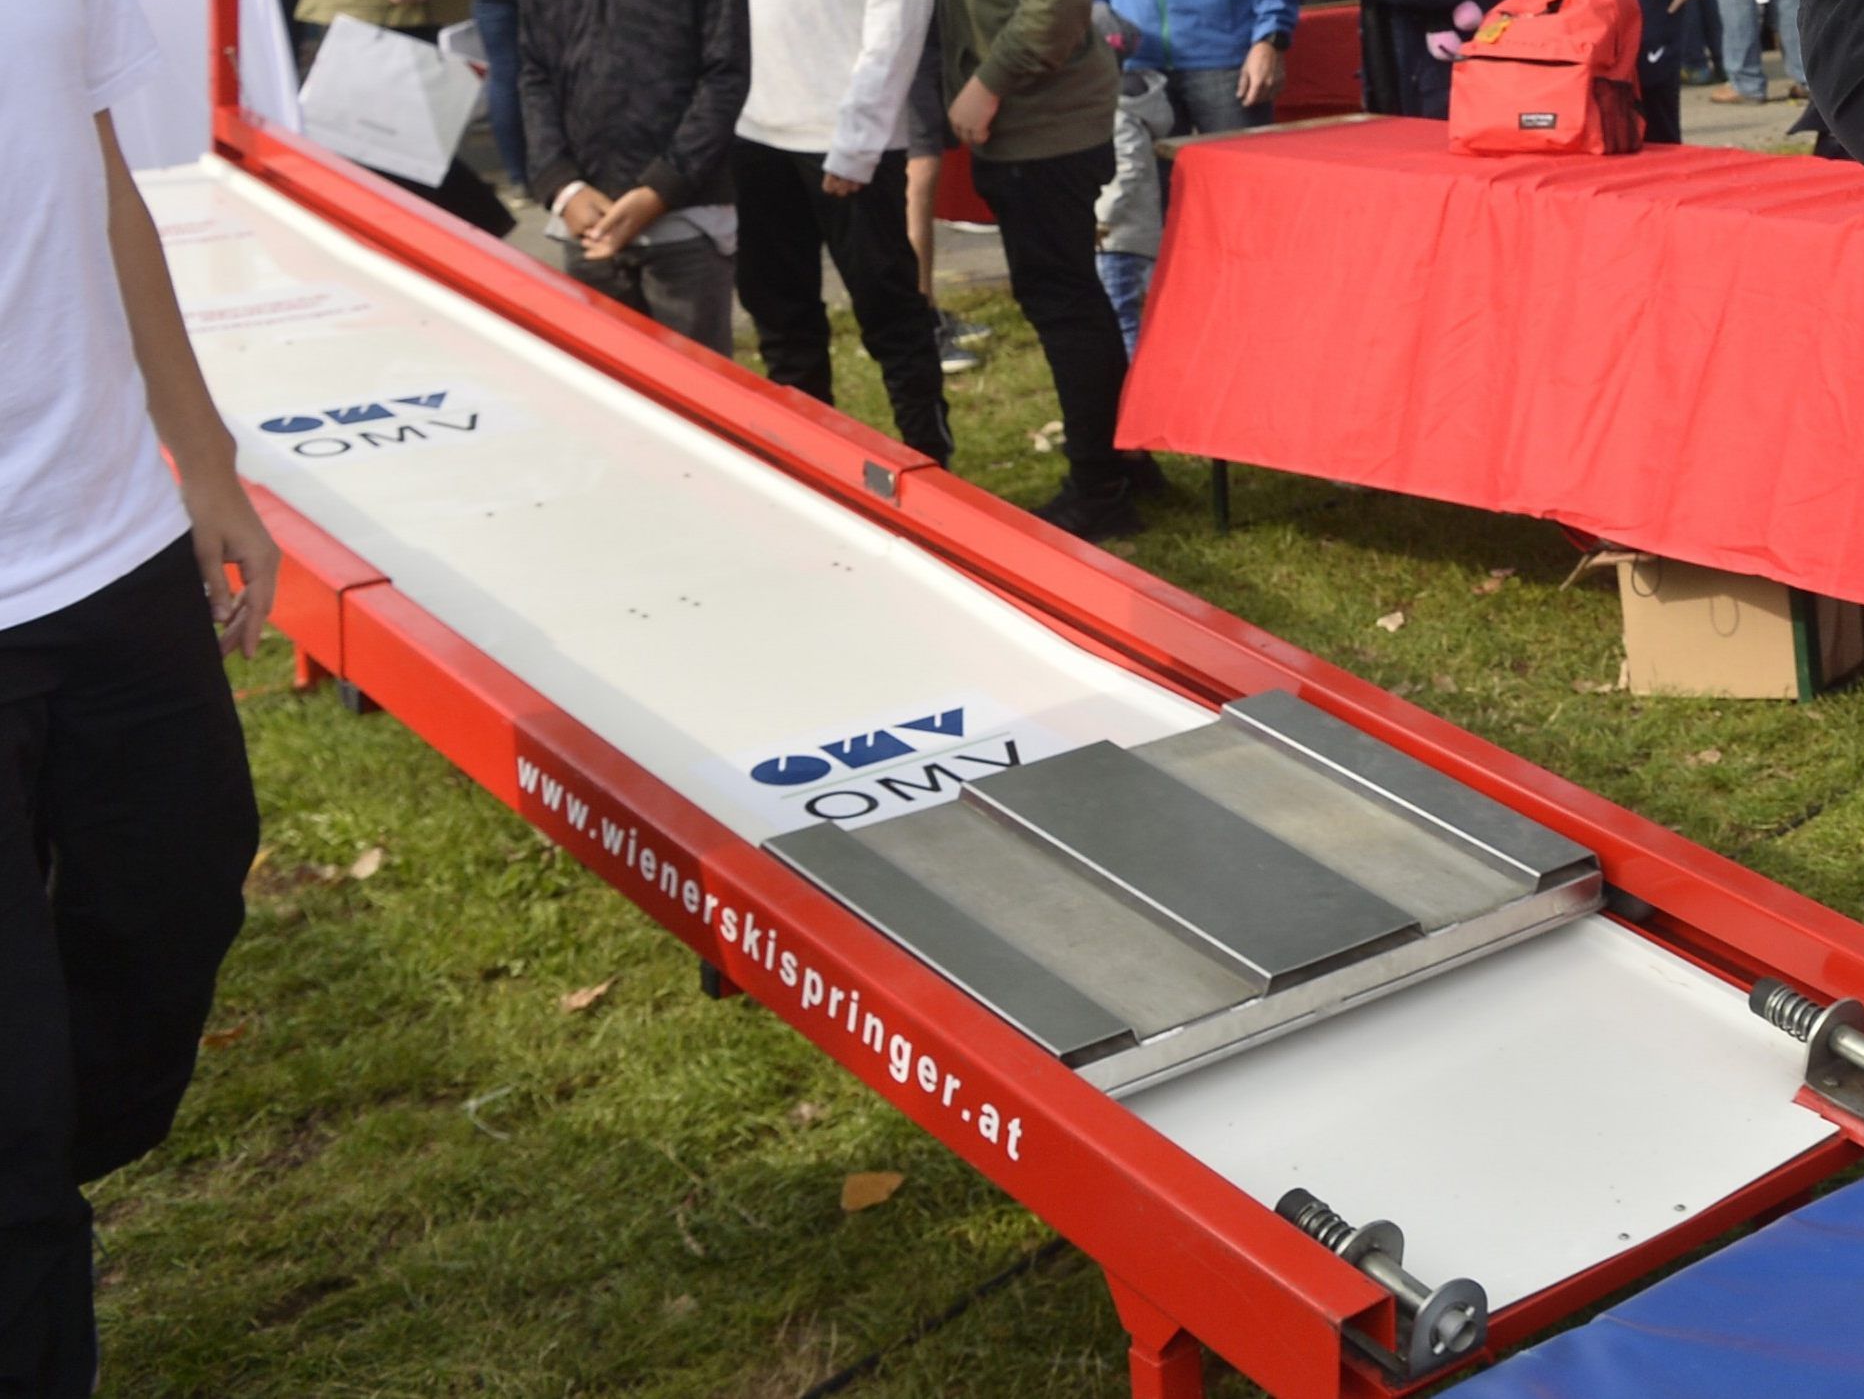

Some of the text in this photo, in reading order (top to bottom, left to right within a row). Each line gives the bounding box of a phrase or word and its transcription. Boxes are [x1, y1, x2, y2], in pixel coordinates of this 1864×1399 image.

[294, 413, 478, 457] OMV
[804, 740, 1021, 819] OMV
[516, 755, 1023, 1161] www.wienerskispringer.at
